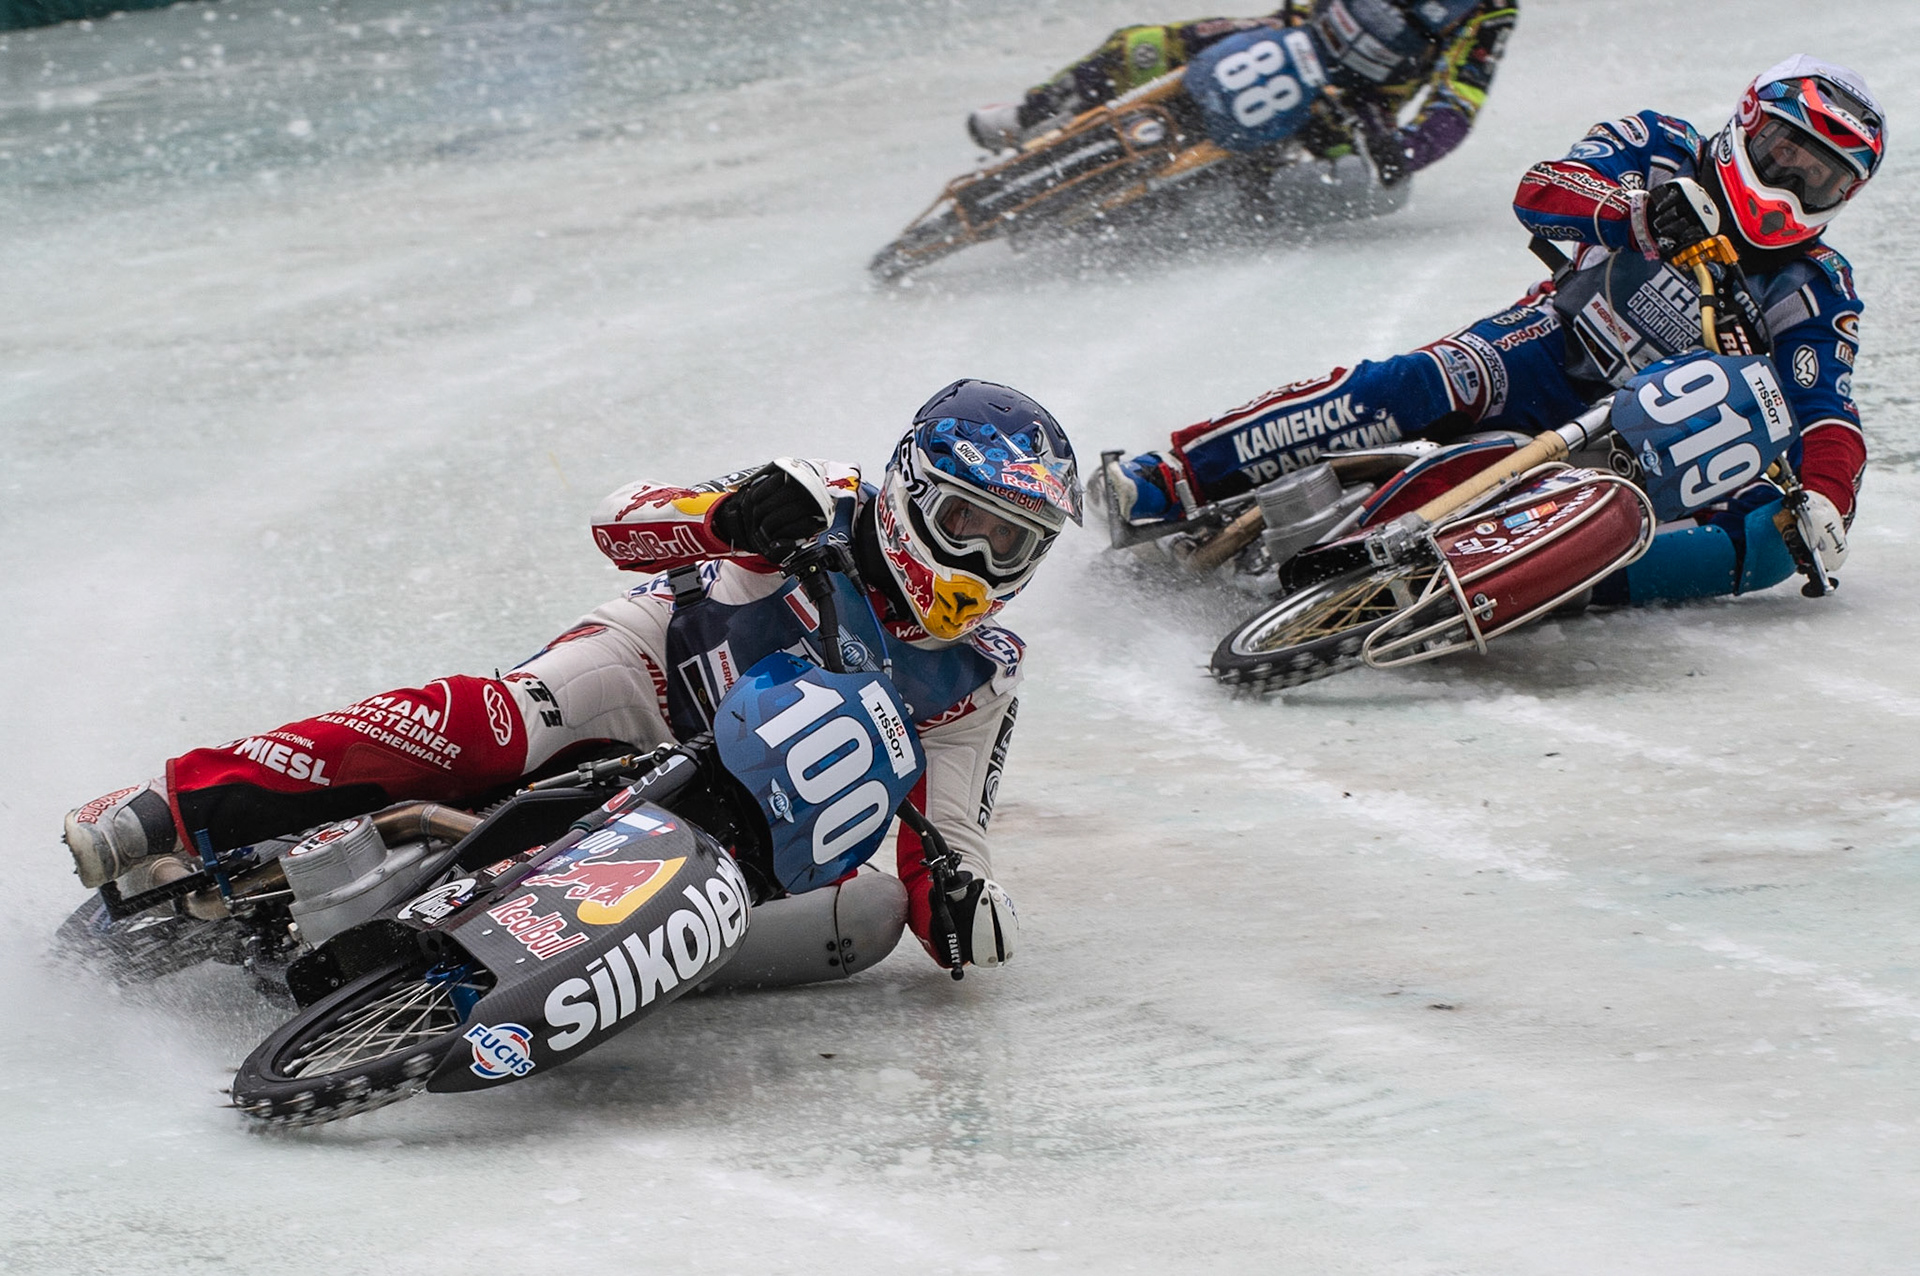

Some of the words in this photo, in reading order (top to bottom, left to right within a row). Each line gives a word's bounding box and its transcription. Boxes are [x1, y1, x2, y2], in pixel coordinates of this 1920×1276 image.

[1215, 40, 1301, 127] 88
[1642, 285, 1699, 336] SPEEDWAY
[1232, 393, 1365, 464] КАМЕНСК-
[1754, 376, 1781, 425] TISSOT
[956, 442, 981, 464] SHOEI
[1638, 359, 1762, 508] 919
[316, 714, 346, 725] BAD
[344, 717, 453, 770] REICHENHALL
[873, 701, 905, 760] TISSOT
[754, 680, 890, 866] 100
[946, 933, 960, 965] FRANKY
[467, 1026, 532, 1076] FUCHS
